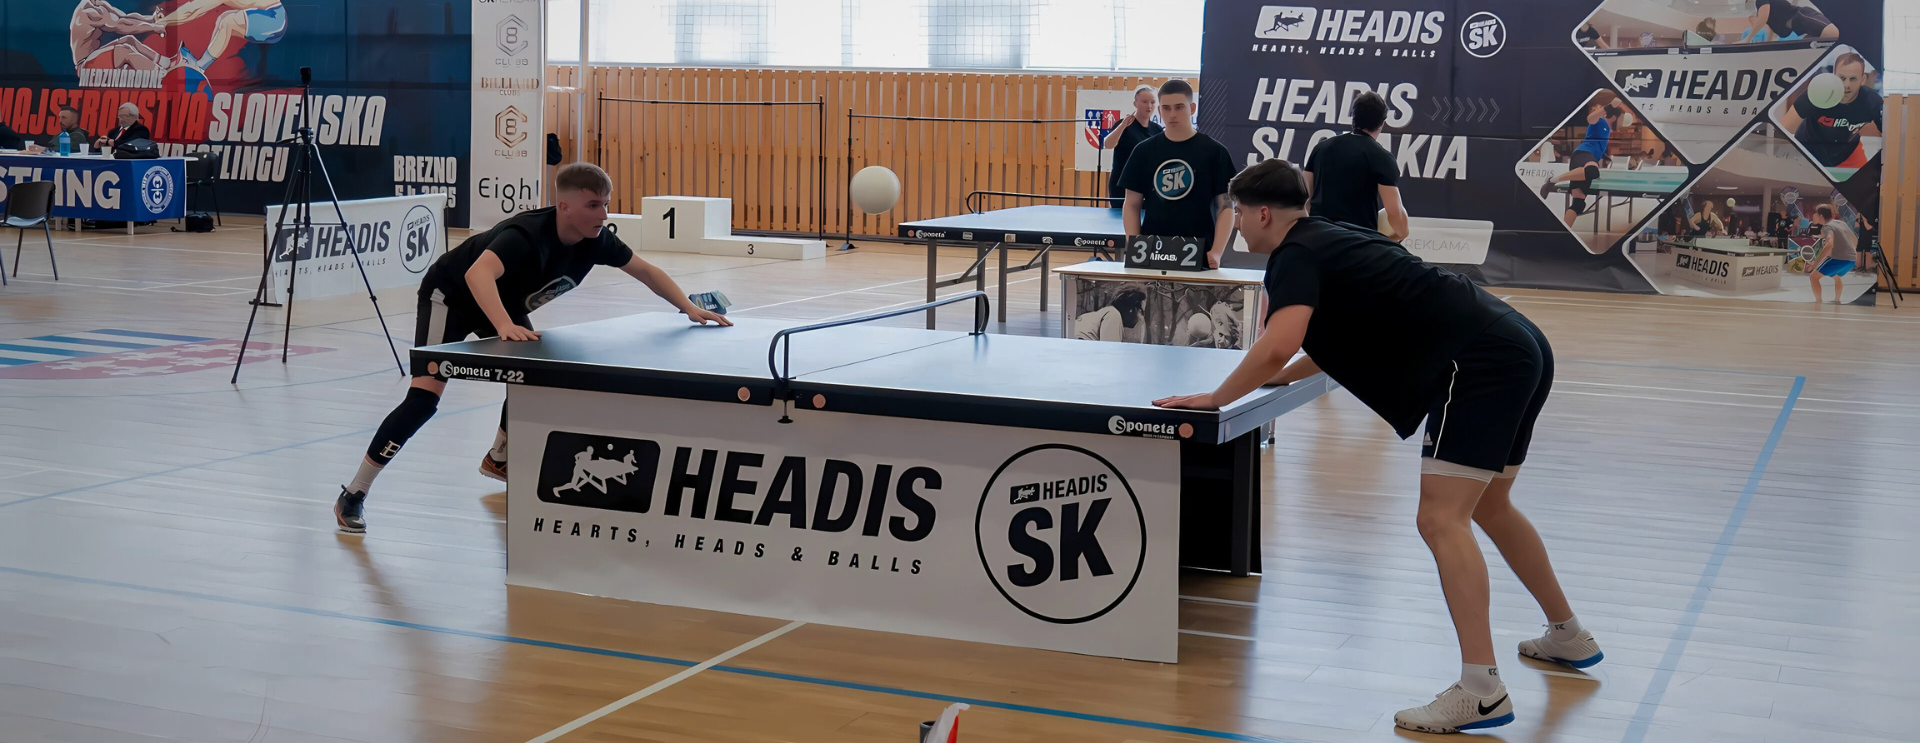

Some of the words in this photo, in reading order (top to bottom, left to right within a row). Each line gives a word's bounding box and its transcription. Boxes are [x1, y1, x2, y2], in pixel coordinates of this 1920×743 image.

[1316, 9, 1445, 45] HEADIS
[1469, 24, 1498, 50] SK
[1252, 44, 1309, 54] HEARTS,
[1320, 47, 1364, 55] HEADS
[1392, 49, 1436, 57] BALLS
[1664, 67, 1798, 100] HEADIS
[209, 92, 387, 146] SLOVENSKA
[1670, 104, 1712, 113] HEADS
[393, 155, 457, 184] BREZNO
[1162, 170, 1186, 192] SK
[663, 207, 676, 239] 1
[315, 221, 391, 258] HEADIS
[405, 223, 431, 262] SK
[747, 244, 754, 255] 3
[1405, 239, 1470, 252] REKLAMA
[1131, 240, 1148, 263] 3
[1155, 240, 1163, 250] 0
[1181, 243, 1198, 266] 2
[275, 266, 312, 278] HEATS,
[1691, 256, 1730, 278] HEADIS
[1756, 265, 1779, 276] HEADIS
[441, 361, 491, 377] Sponeta
[495, 368, 524, 383] 7-22
[1110, 417, 1175, 435] Sponeta
[664, 446, 942, 542] HEADIS
[1043, 473, 1108, 500] HEADIS
[533, 517, 650, 547] HEARTS,
[674, 533, 765, 558] HEADS
[791, 546, 803, 562] &
[828, 551, 922, 574] BALLS
[1007, 497, 1114, 587] SK
